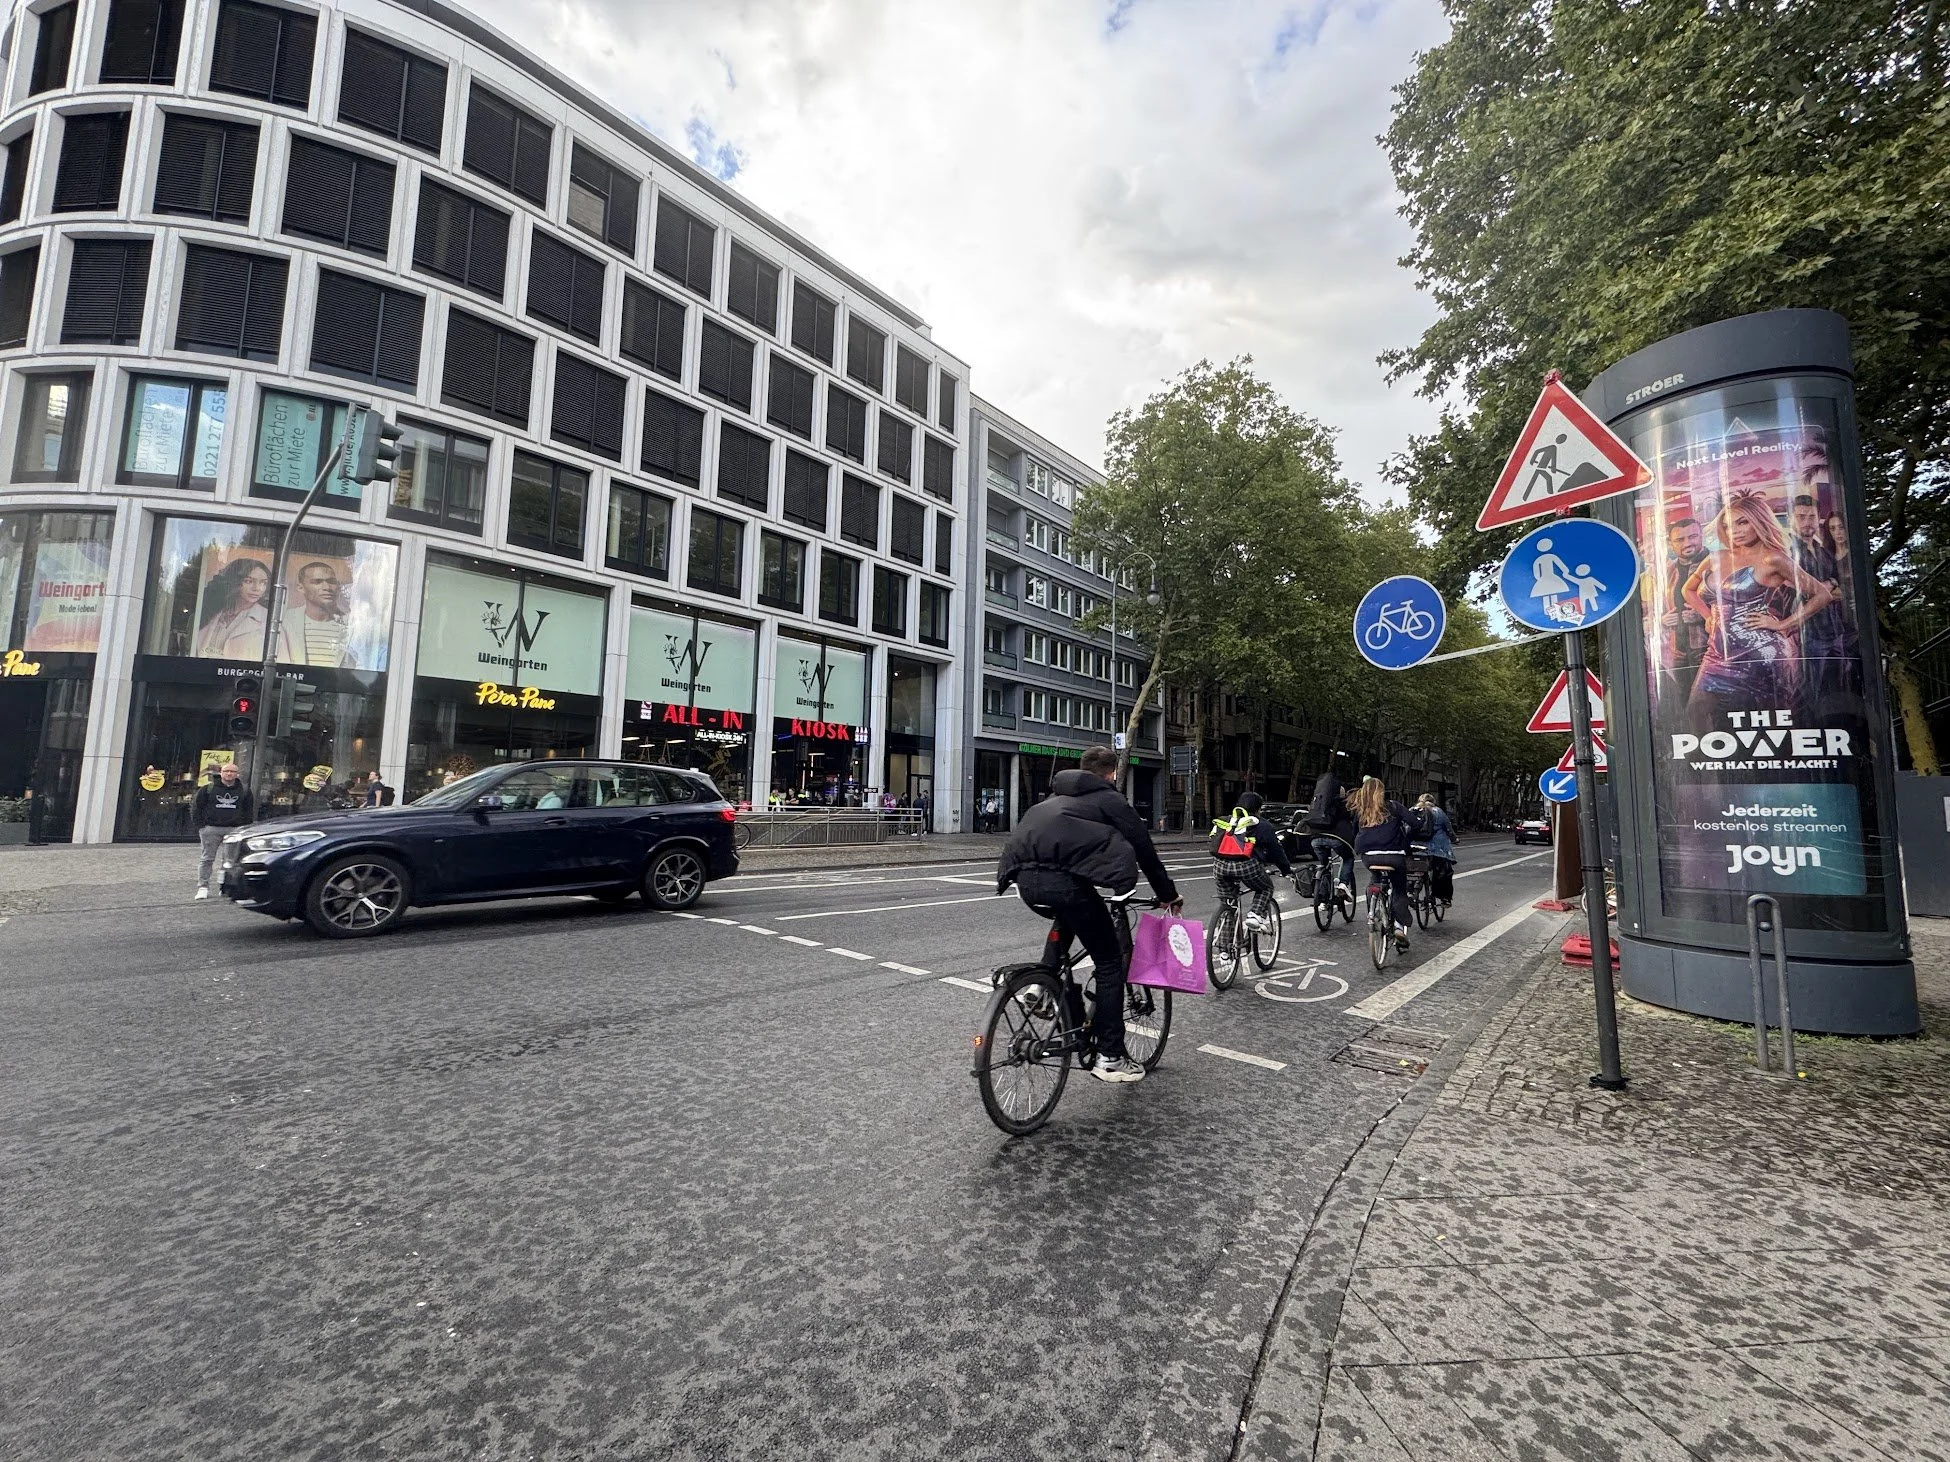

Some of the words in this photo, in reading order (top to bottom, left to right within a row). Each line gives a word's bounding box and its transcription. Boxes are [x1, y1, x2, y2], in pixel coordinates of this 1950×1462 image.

[263, 404, 288, 484] Büroflächen
[290, 427, 306, 462] Miete
[1676, 457, 1709, 470] Next
[1712, 447, 1748, 462] Level
[1752, 440, 1802, 455] Reality.
[203, 444, 220, 476] 0221
[287, 465, 300, 487] zur
[39, 582, 106, 601] Weingart
[3, 650, 41, 677] Pane
[475, 681, 519, 706] Peter
[519, 686, 556, 710] Pane
[661, 677, 711, 693] Weingrten
[663, 704, 703, 726] ALL
[723, 710, 743, 729] IN
[1728, 709, 1793, 728] THE
[791, 718, 850, 740] KIOSK
[1671, 729, 1853, 759] POWER
[1690, 761, 1723, 771] WER
[1726, 760, 1756, 770] HAT
[1758, 760, 1782, 769] DIE
[1721, 804, 1818, 818] Jederzeit
[1693, 820, 1769, 832] kostenlos
[1773, 822, 1847, 833] streamen
